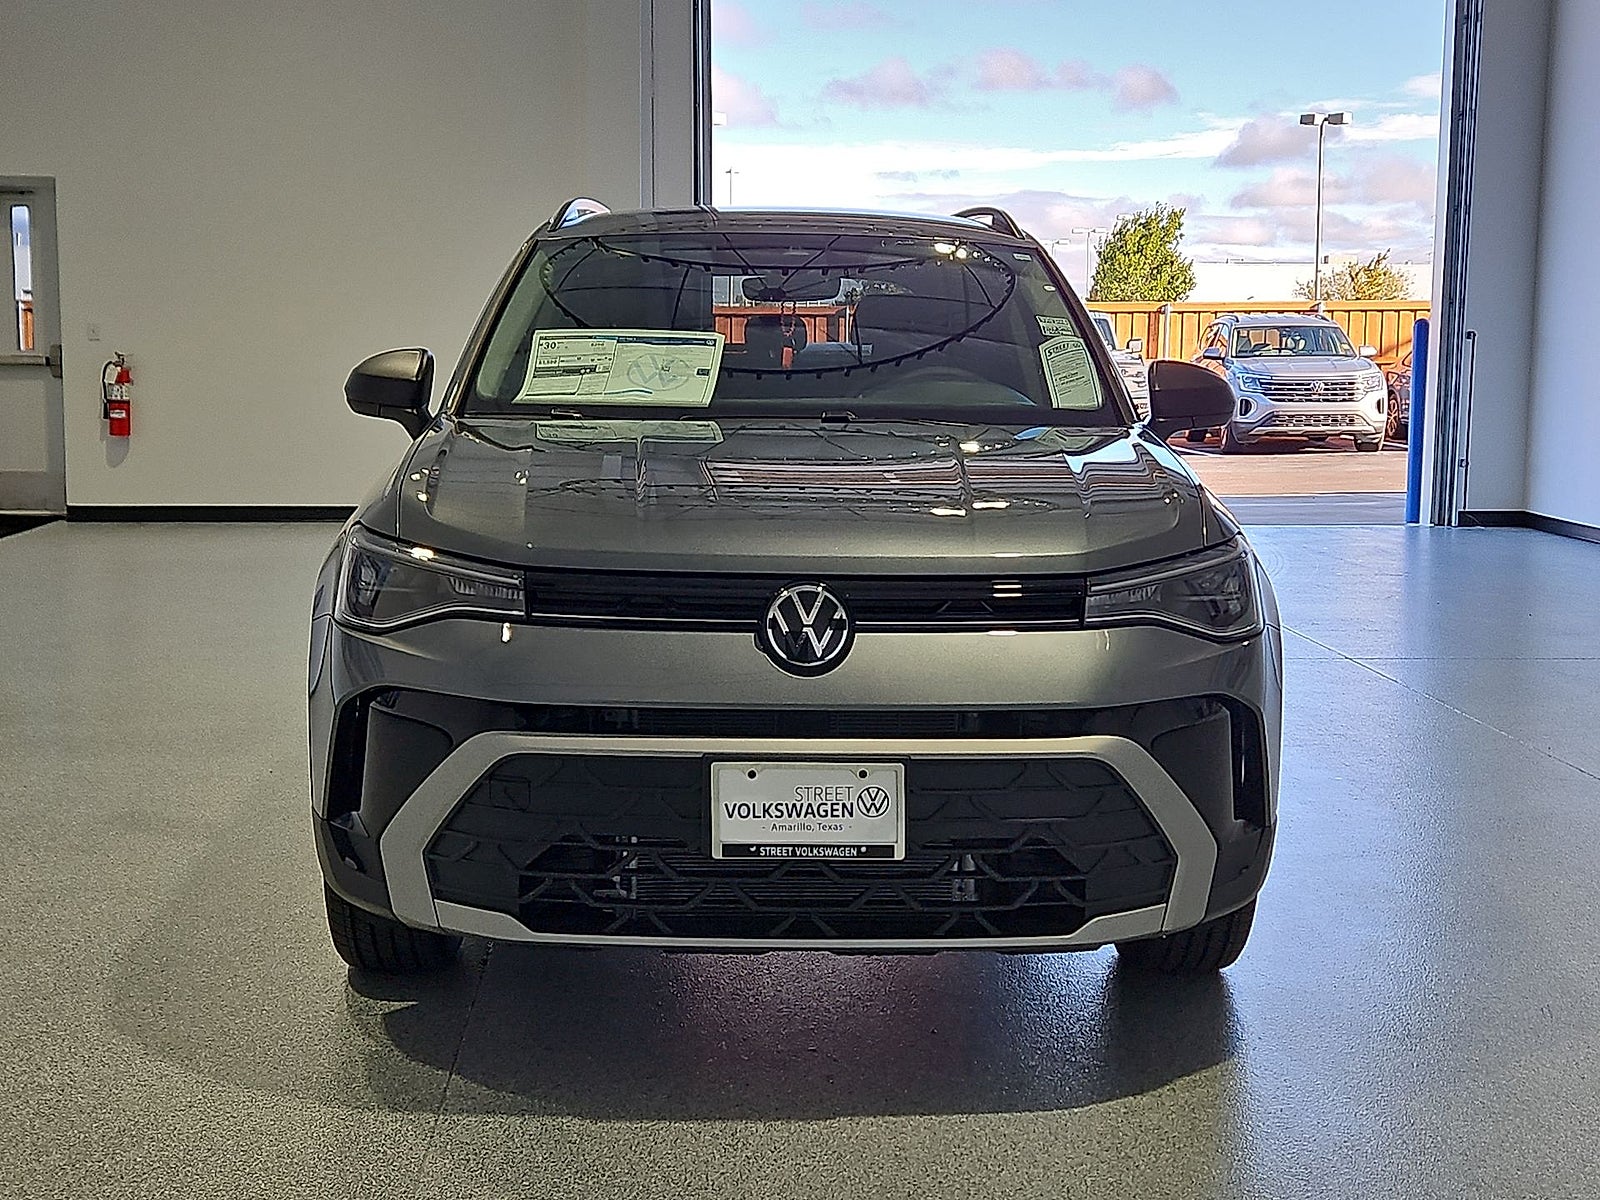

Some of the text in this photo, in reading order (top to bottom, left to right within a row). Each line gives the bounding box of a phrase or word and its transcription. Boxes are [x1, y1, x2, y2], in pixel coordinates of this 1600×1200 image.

[794, 786, 854, 802] STREET
[724, 802, 854, 819] VOLKSWAGEN
[770, 822, 843, 832] Amarillo, Texas
[759, 846, 858, 856] STREET VOLKSWAGEN
